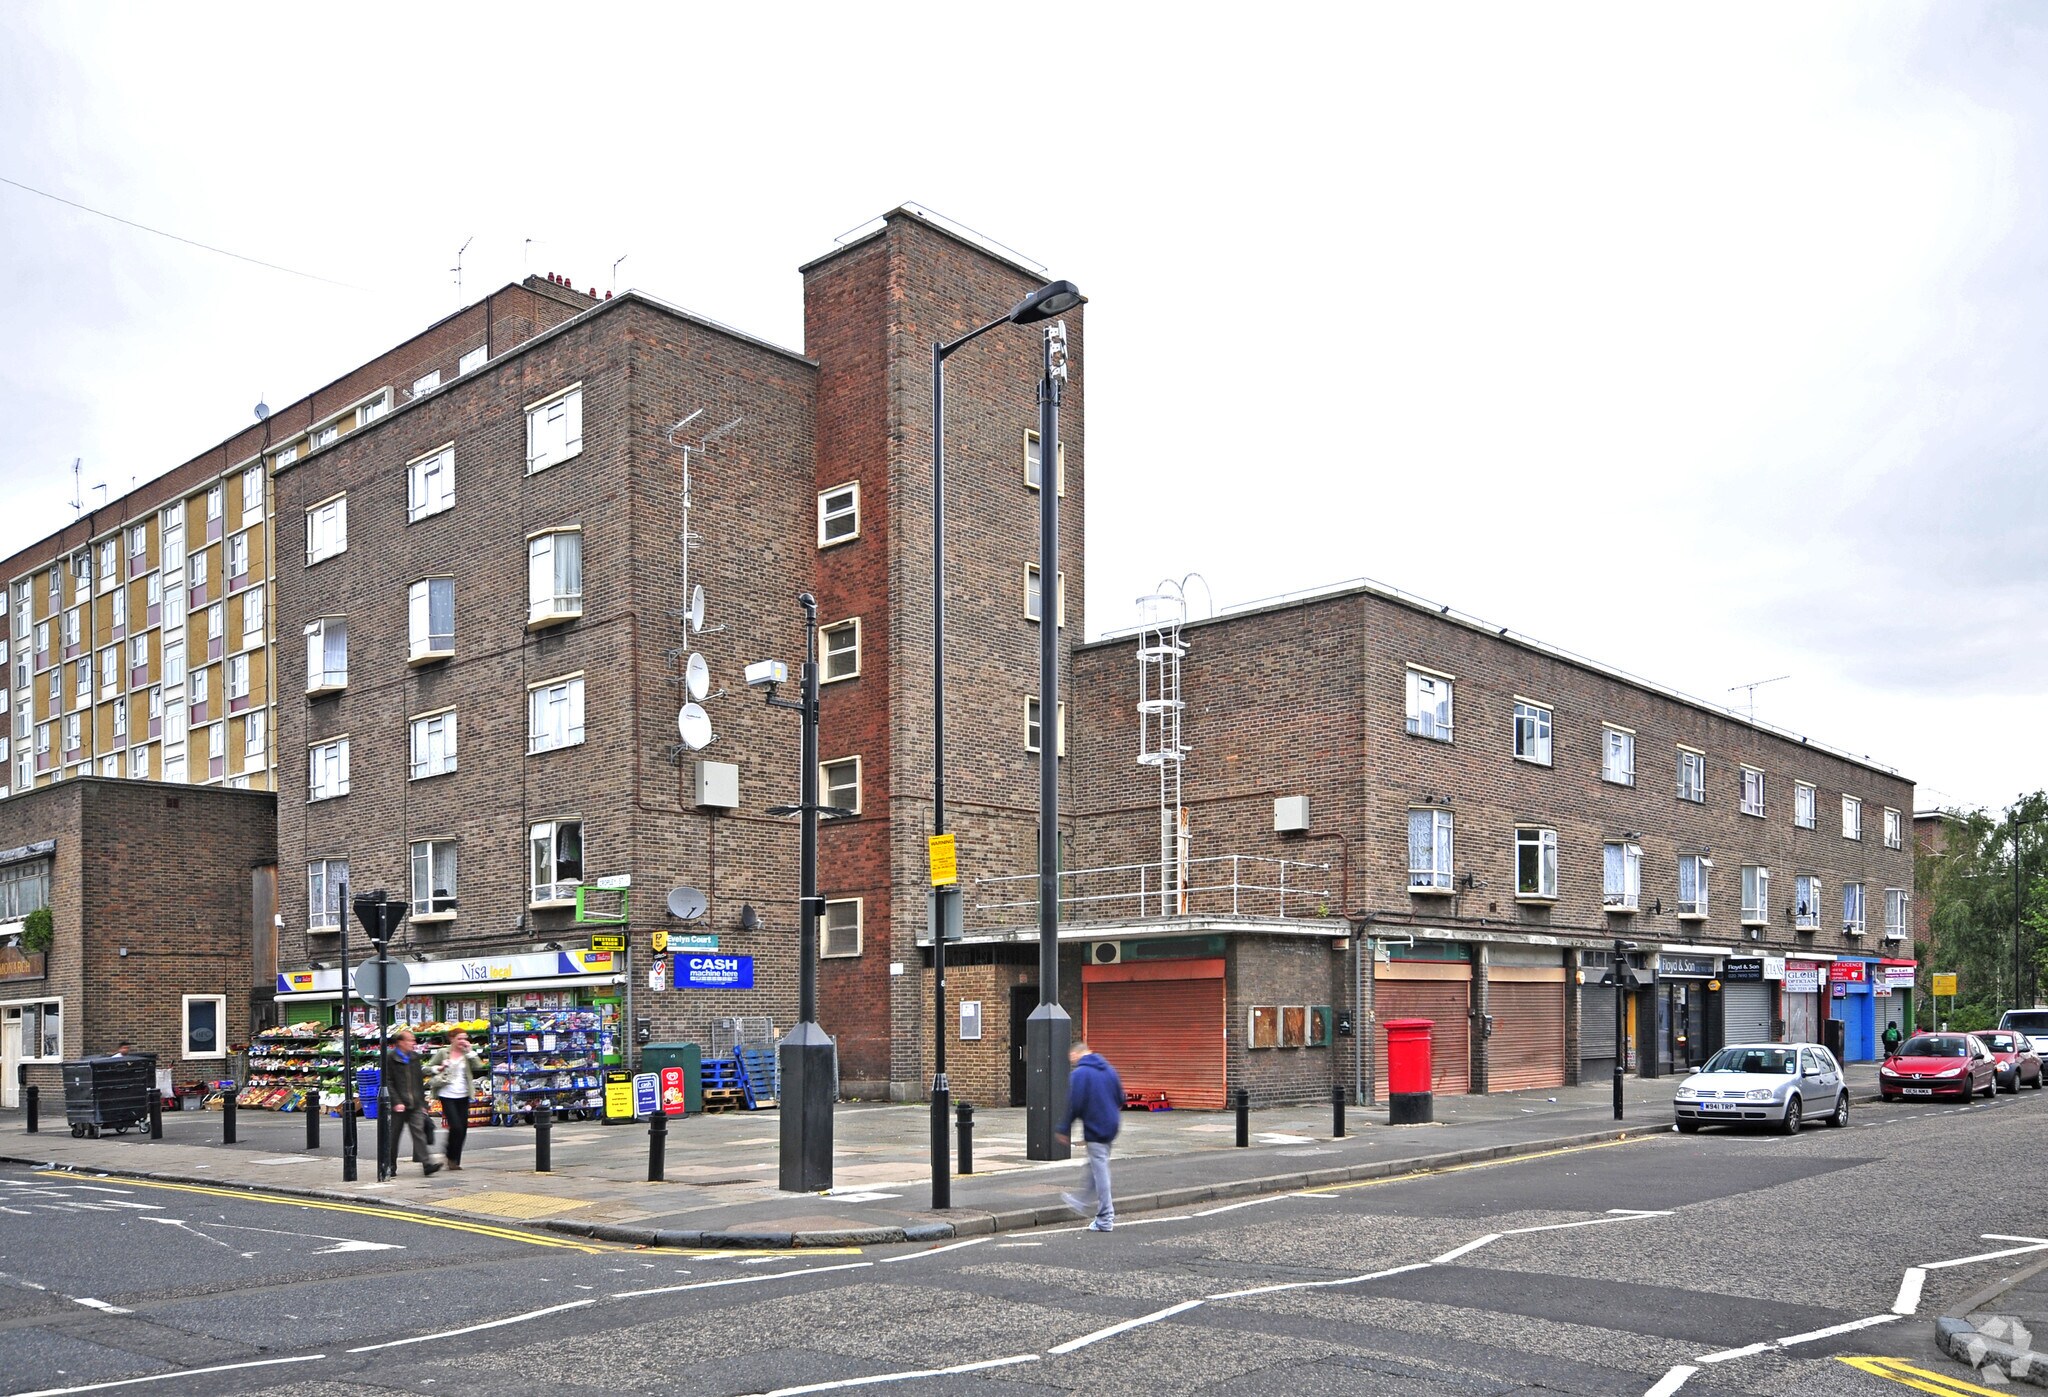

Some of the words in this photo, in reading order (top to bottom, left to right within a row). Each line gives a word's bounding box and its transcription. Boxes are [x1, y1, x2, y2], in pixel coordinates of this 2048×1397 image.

[667, 935, 690, 944] Evelyn
[691, 935, 712, 943] Court
[690, 958, 738, 970] CASH
[1662, 959, 1677, 973] Floyd
[1678, 960, 1684, 972] &
[1685, 959, 1695, 972] Son
[461, 962, 487, 980] Nisa
[490, 963, 512, 978] local
